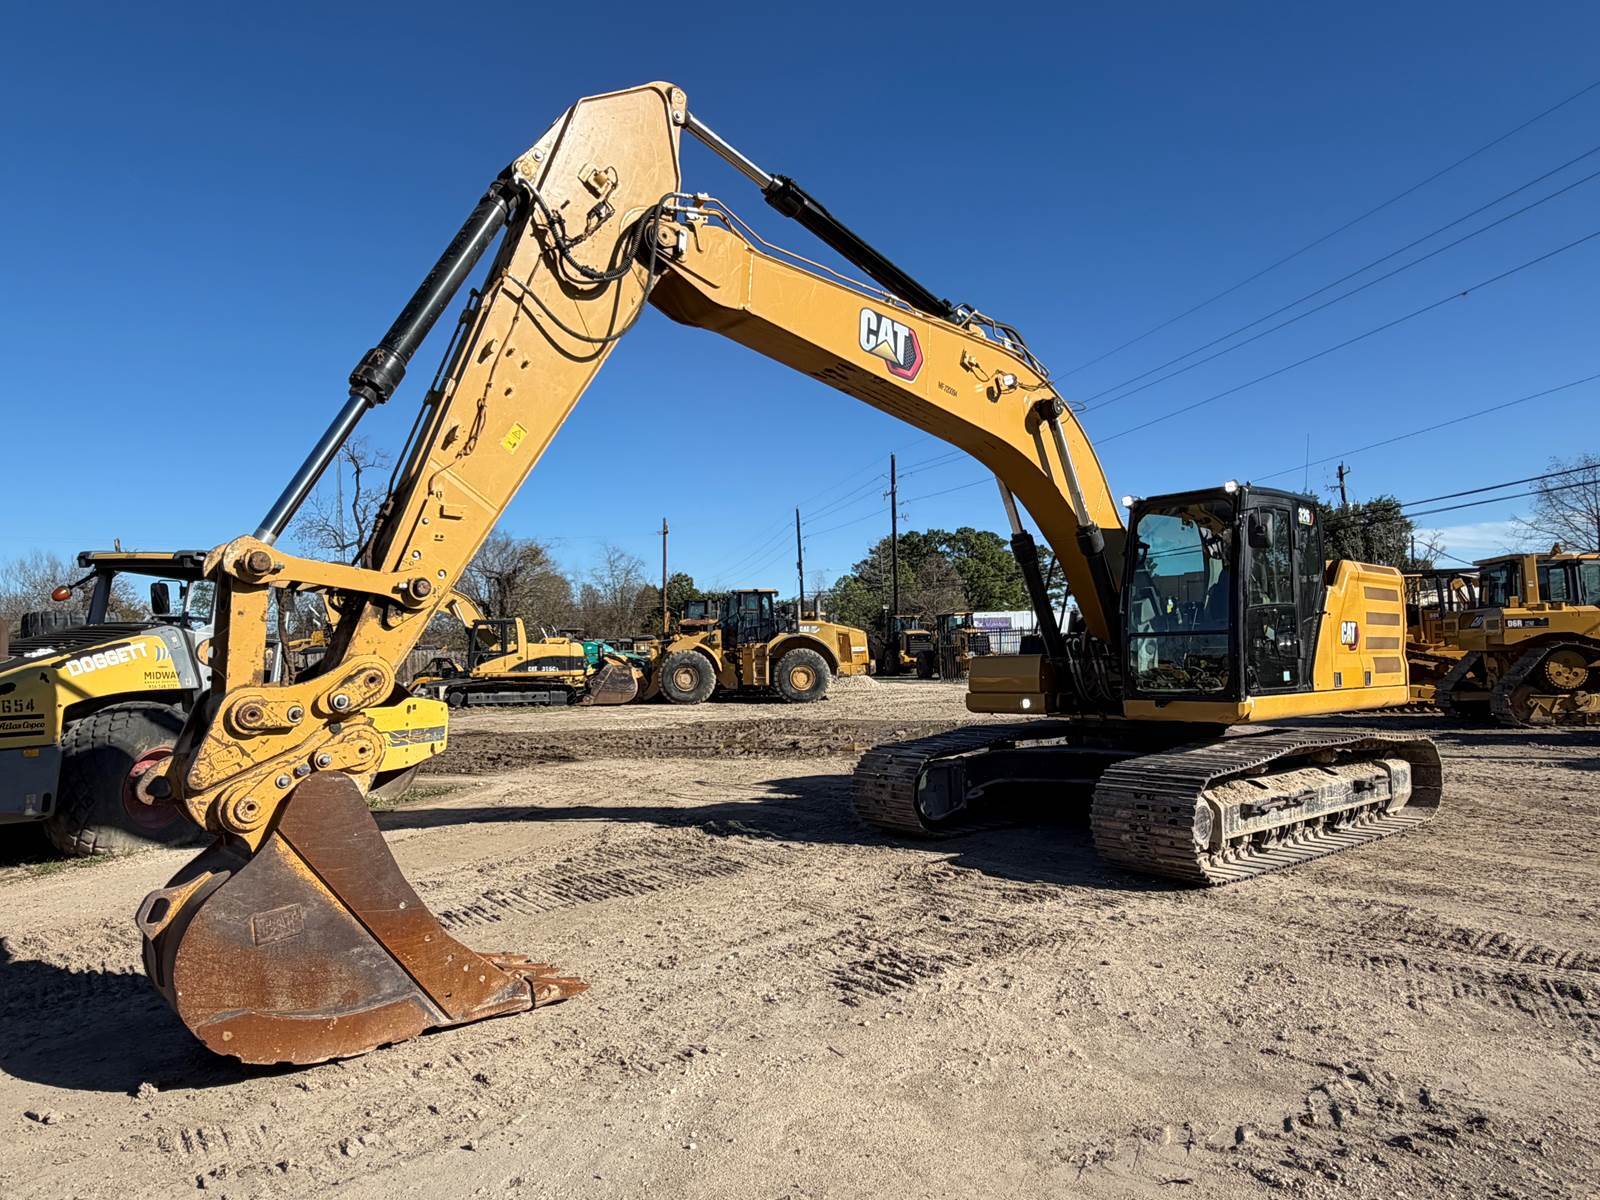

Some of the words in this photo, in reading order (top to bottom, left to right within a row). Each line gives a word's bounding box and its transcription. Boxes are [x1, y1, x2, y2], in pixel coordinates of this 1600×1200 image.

[860, 308, 910, 365] CAT
[1507, 619, 1523, 627] D6R
[1341, 621, 1356, 645] CAT
[66, 643, 147, 677] DOGGETT
[144, 671, 181, 680] MIDWAY
[0, 722, 21, 730] Atlas
[22, 721, 46, 729] Copco
